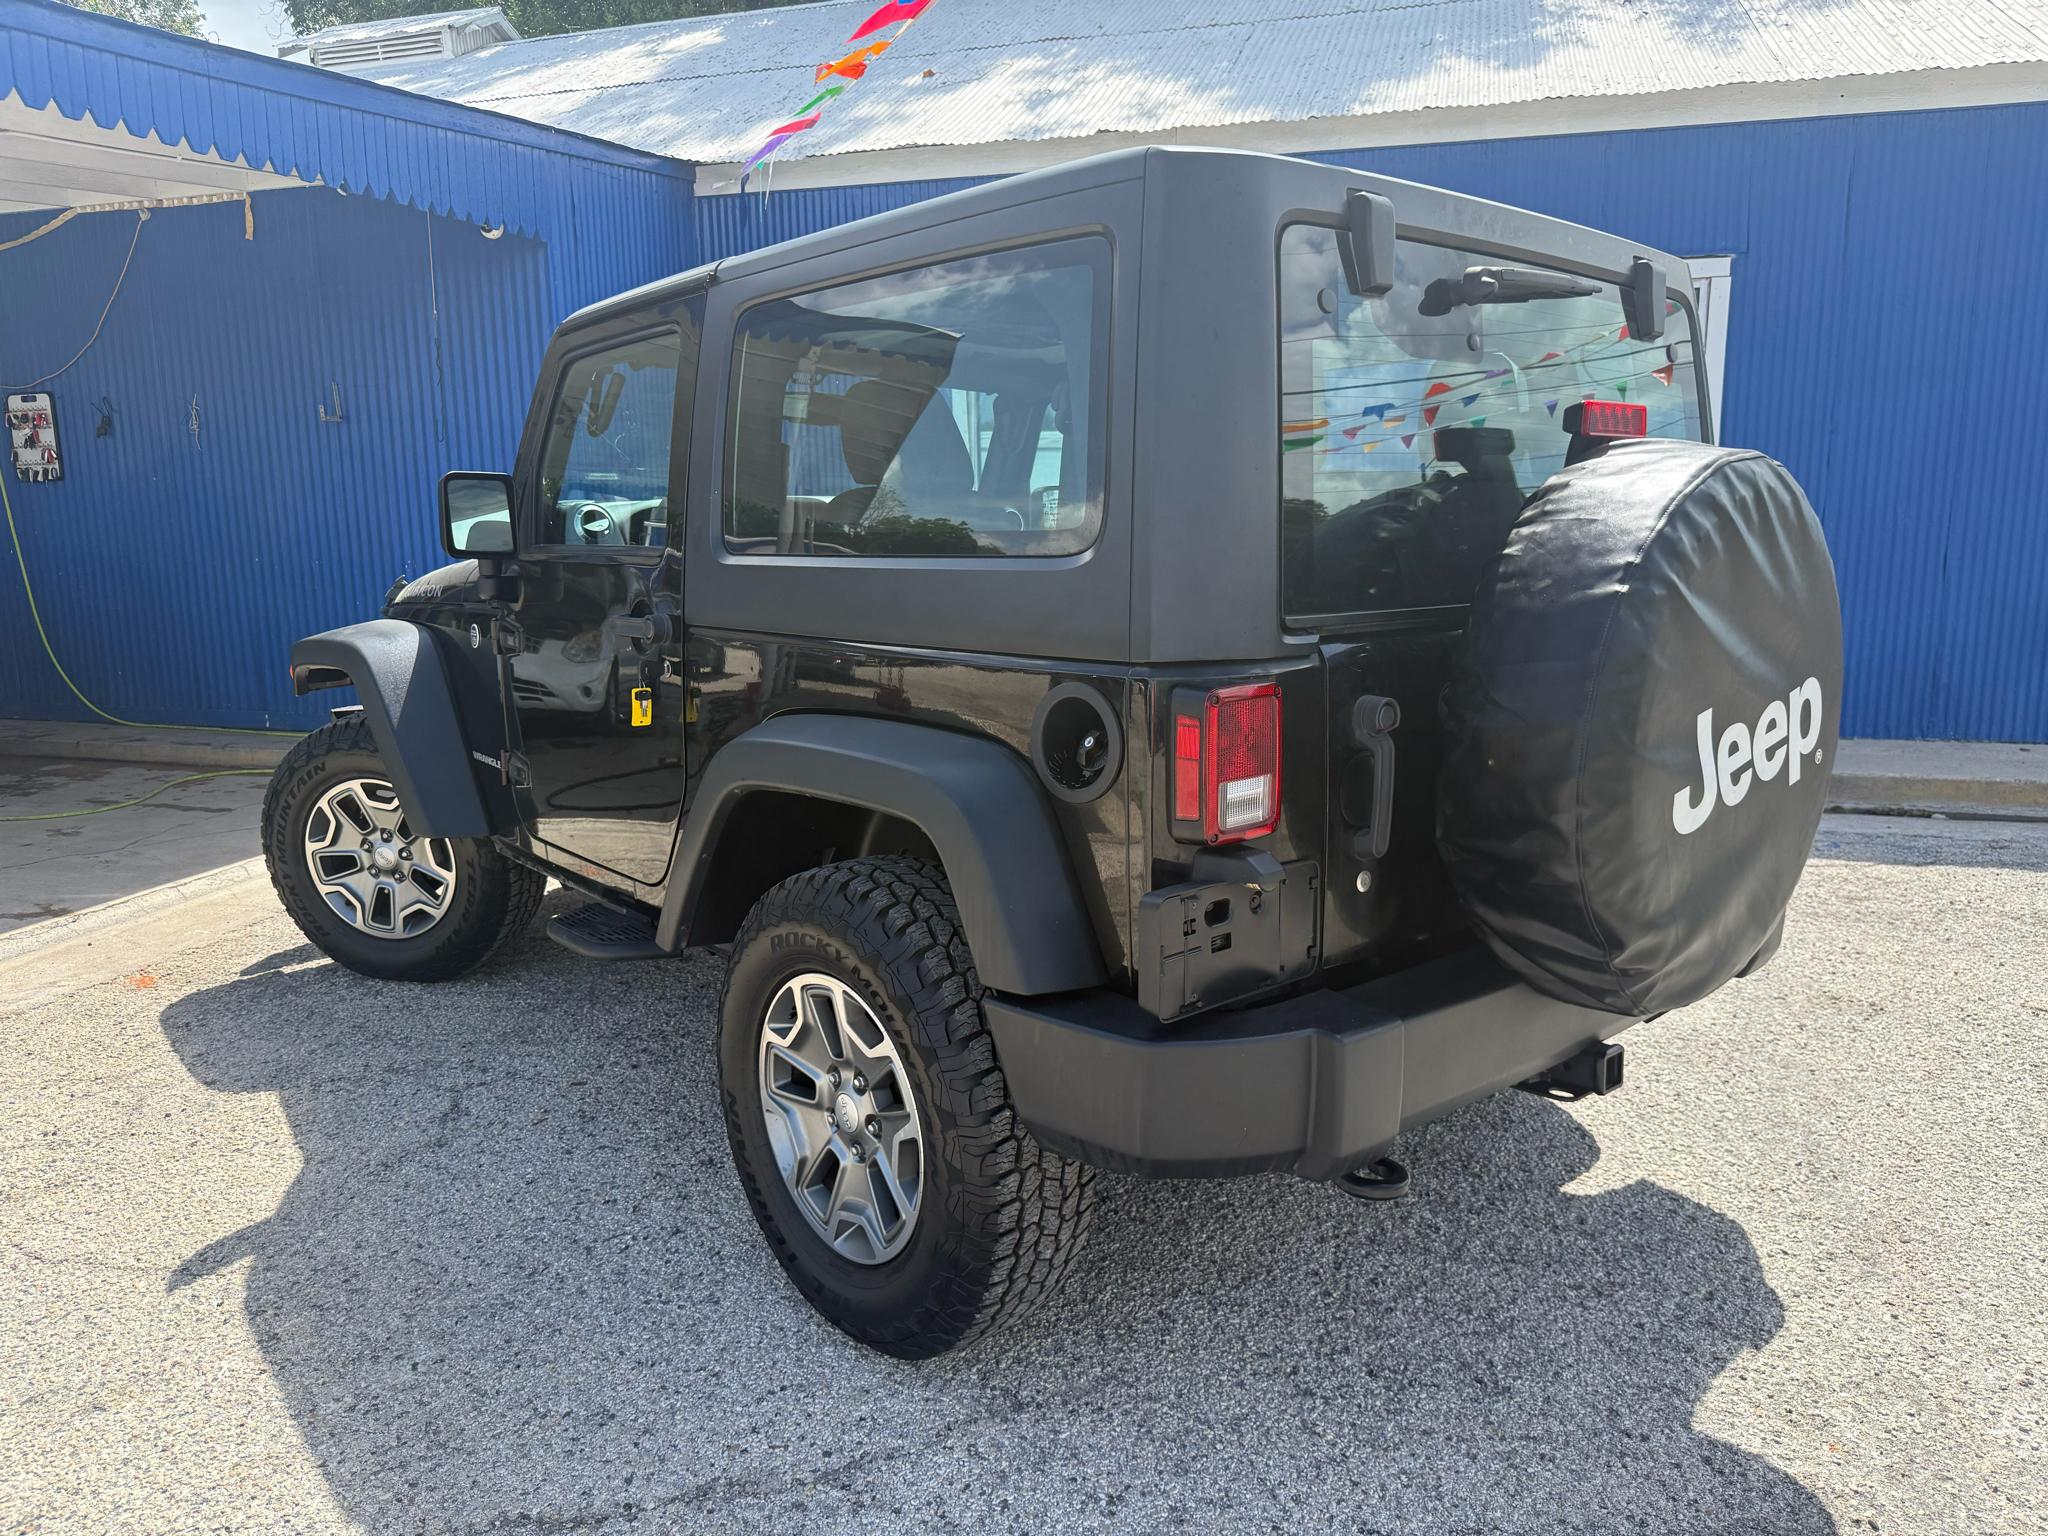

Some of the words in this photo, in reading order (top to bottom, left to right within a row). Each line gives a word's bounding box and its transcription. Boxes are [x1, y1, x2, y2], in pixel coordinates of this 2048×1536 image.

[472, 750, 502, 769] WRANGLE
[1672, 676, 1823, 835] Jeep
[276, 761, 327, 865] MOUNTAIN
[769, 931, 849, 965] ROCKY
